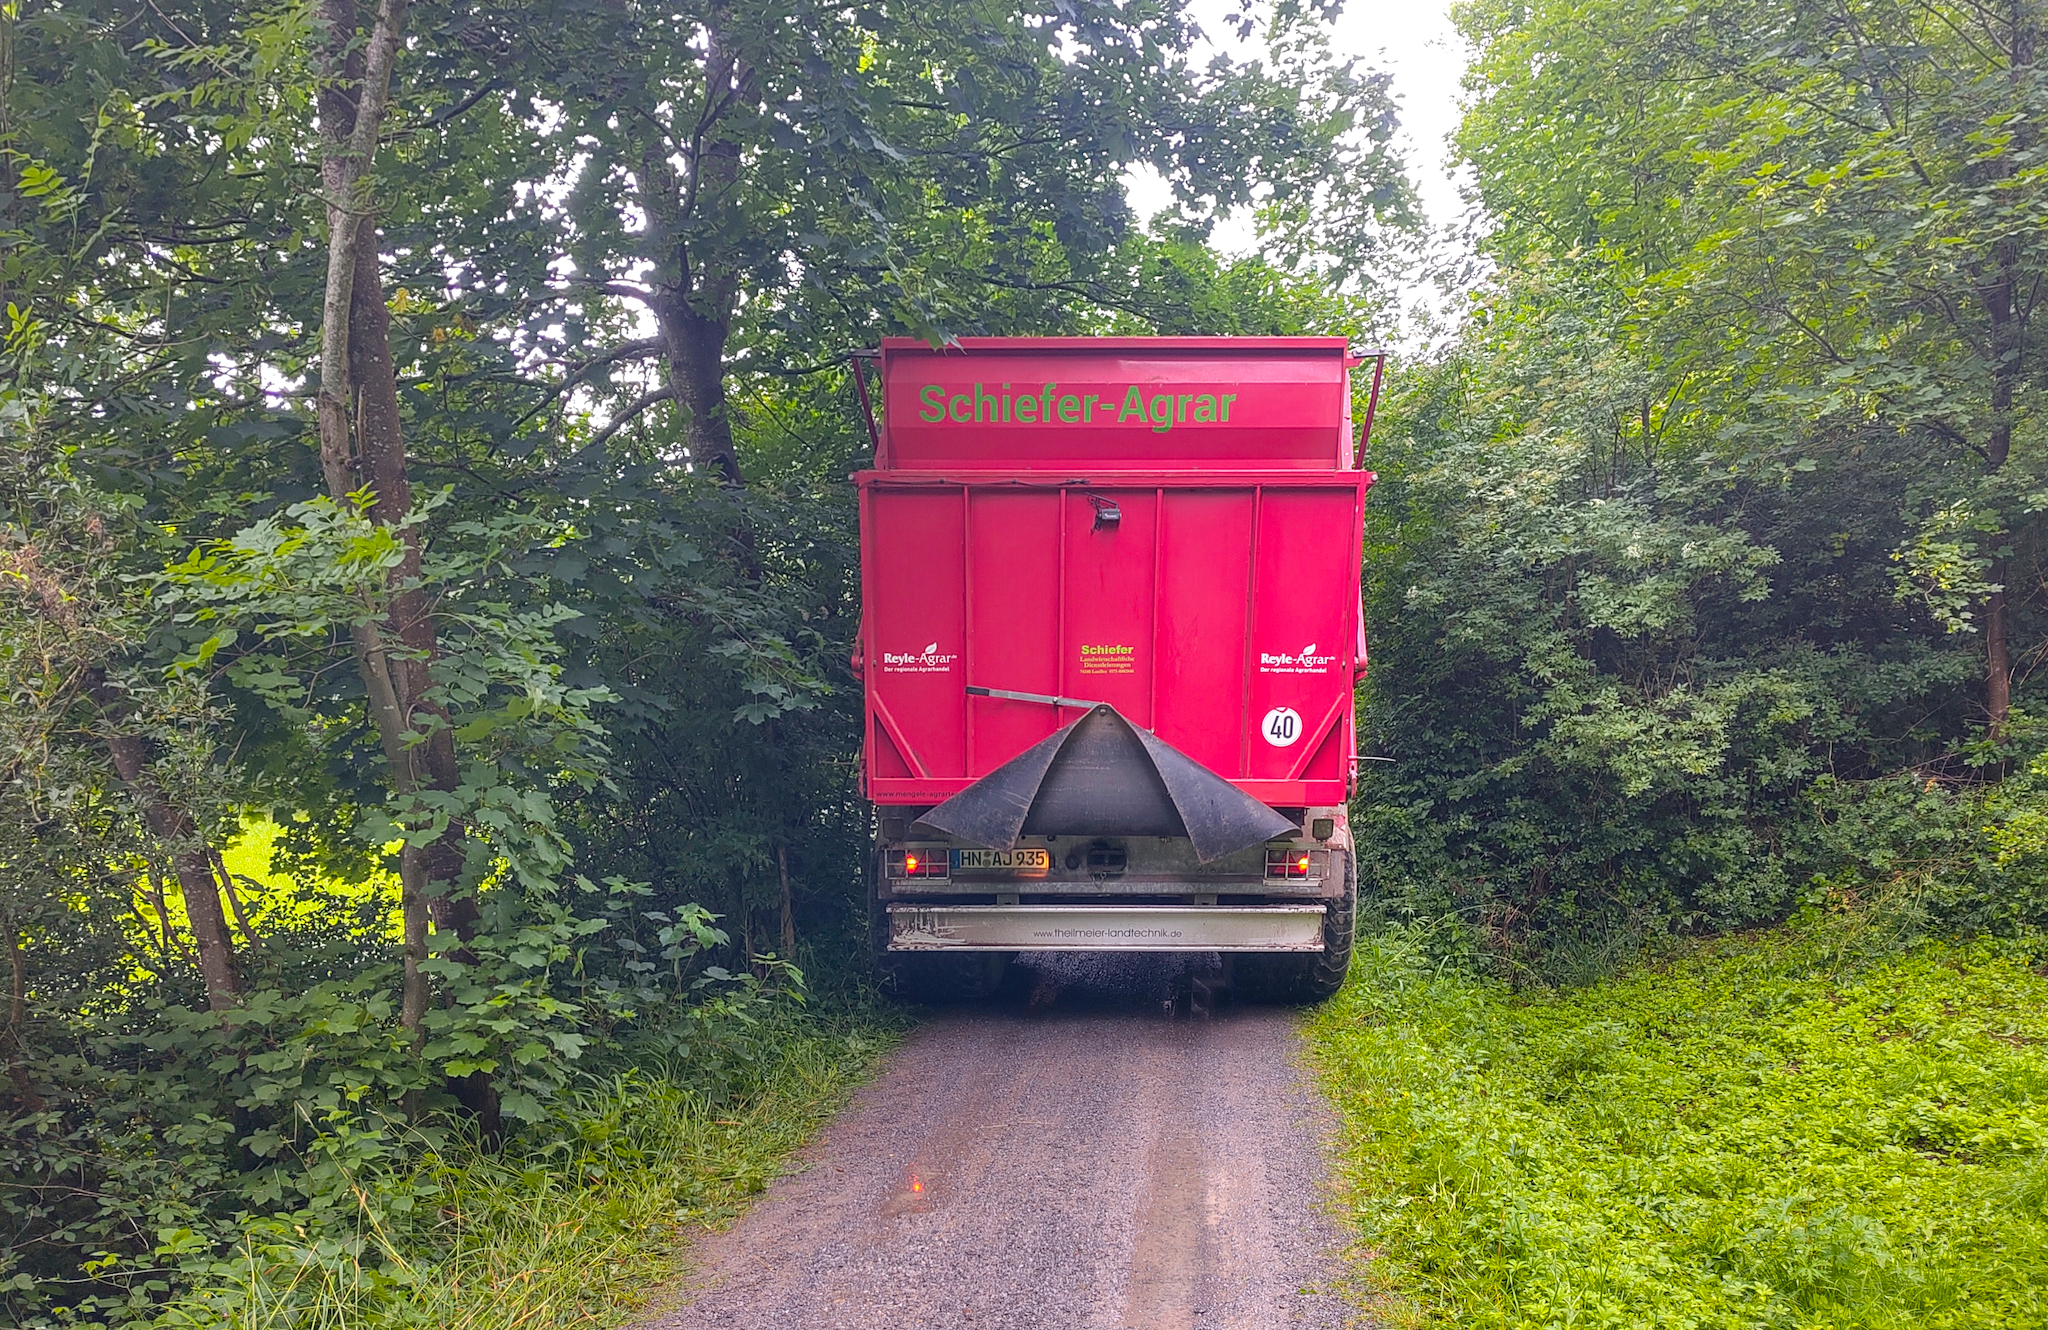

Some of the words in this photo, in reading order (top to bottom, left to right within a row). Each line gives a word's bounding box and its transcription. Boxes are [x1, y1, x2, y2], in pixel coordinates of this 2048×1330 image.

[918, 383, 1236, 433] Schiefer-Agrar
[1081, 645, 1134, 655] Schiefer
[1270, 715, 1294, 739] 40
[961, 851, 981, 866] HN
[993, 851, 1012, 866] AJ
[1016, 851, 1045, 866] 935
[1033, 928, 1183, 938] www.theilmeier-landtechnik.de
